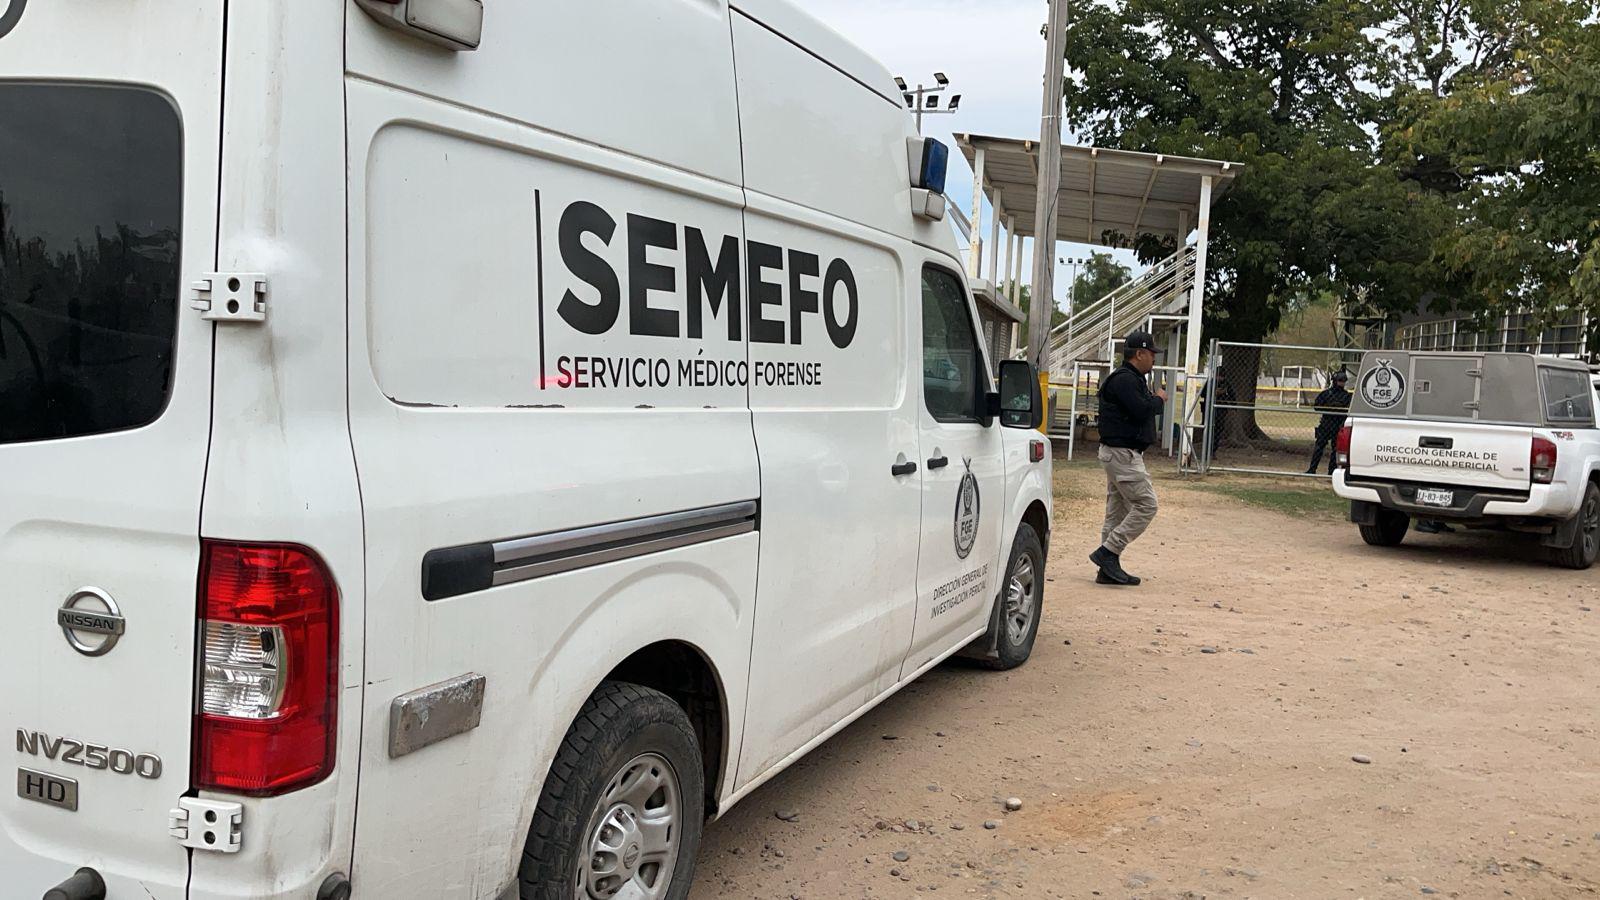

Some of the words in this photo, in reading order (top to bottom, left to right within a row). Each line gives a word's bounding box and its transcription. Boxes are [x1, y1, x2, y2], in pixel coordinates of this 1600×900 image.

[556, 200, 859, 349] SEMEFO
[557, 355, 670, 389] SERVICIO
[677, 348, 749, 388] MÉDICO
[755, 361, 822, 386] FORENSE
[1372, 389, 1392, 397] FGE
[1374, 454, 1449, 468] INVESTIGACIÓN
[1451, 461, 1500, 472] PERICIAL
[1376, 444, 1429, 456] DIRECCIÓN
[1431, 448, 1480, 460] GENERAL
[1483, 452, 1498, 461] DE
[961, 519, 973, 536] FGE
[933, 575, 961, 601] DIRECCIÓN
[961, 567, 982, 586] GENERAL
[981, 563, 989, 576] DE
[930, 590, 969, 620] INVESTIGACIÓN
[968, 579, 987, 599] PERICIAL
[61, 612, 115, 631] NISSAN
[16, 727, 163, 780] NV2500
[26, 774, 66, 803] HD
